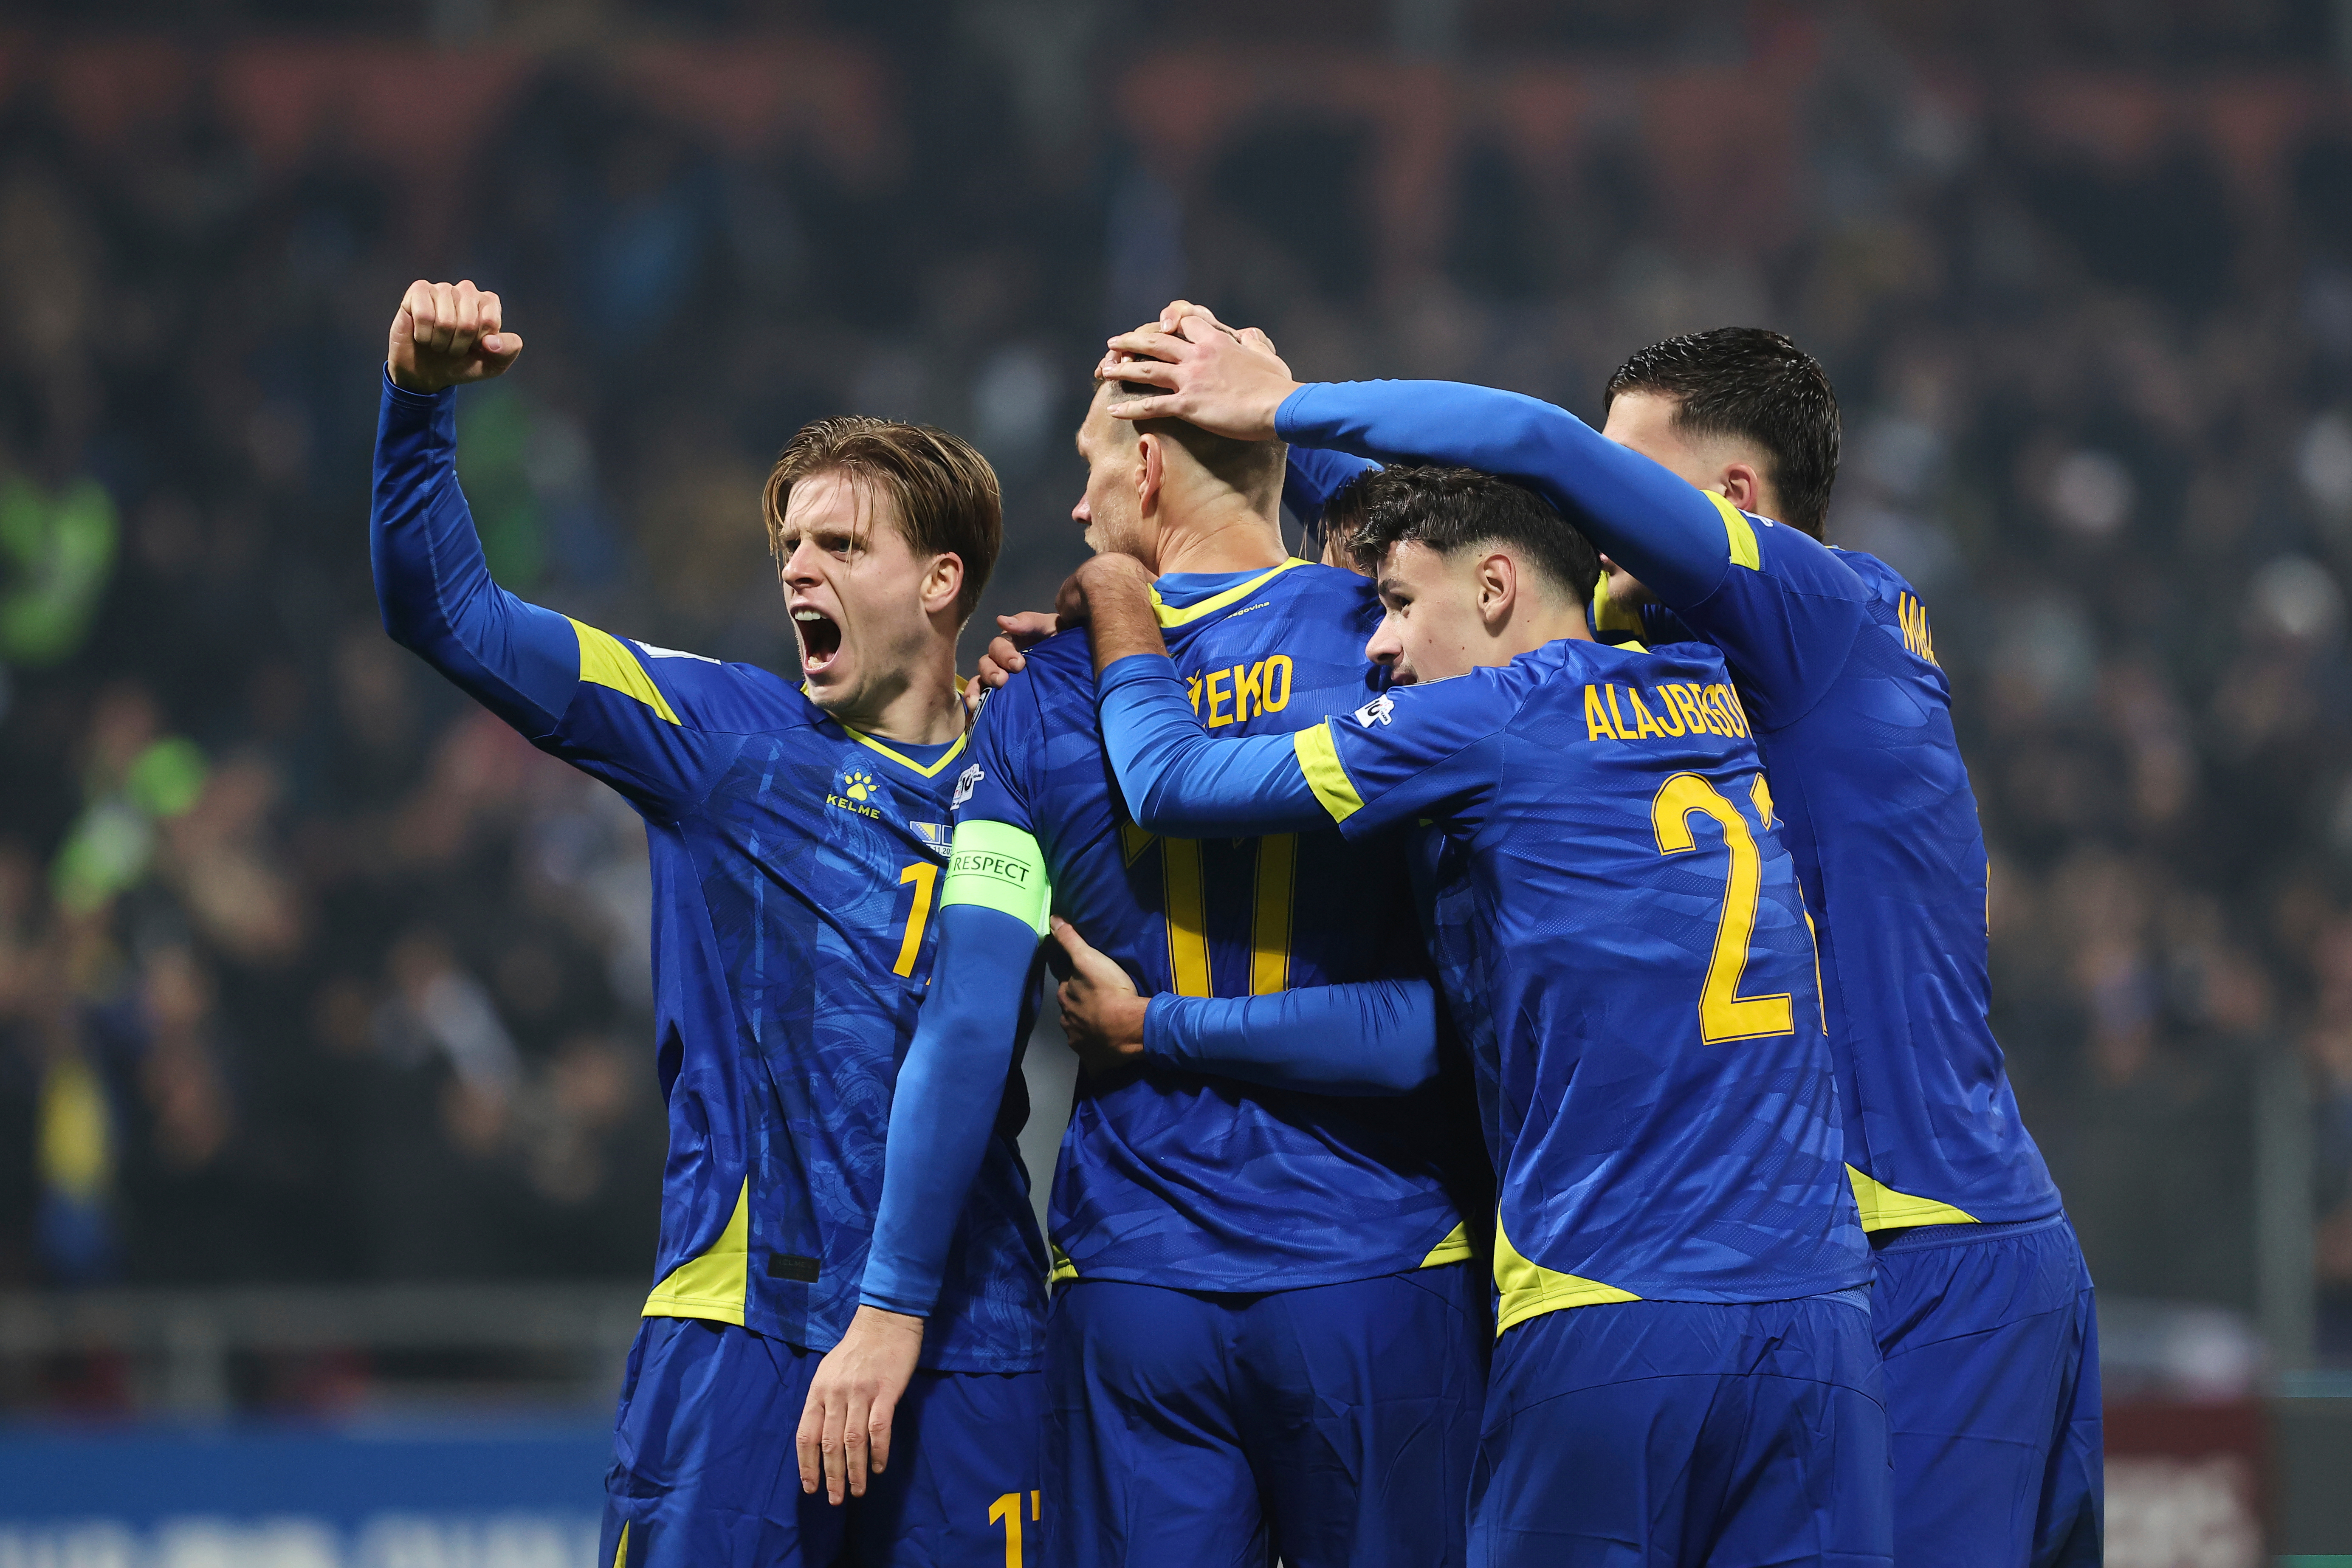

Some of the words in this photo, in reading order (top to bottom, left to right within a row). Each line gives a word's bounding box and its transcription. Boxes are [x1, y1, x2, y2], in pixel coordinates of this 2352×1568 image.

[826, 794, 880, 819] KELME
[953, 856, 1029, 882] RESPECT
[892, 861, 939, 986] 1
[988, 1489, 1041, 1568] 1
